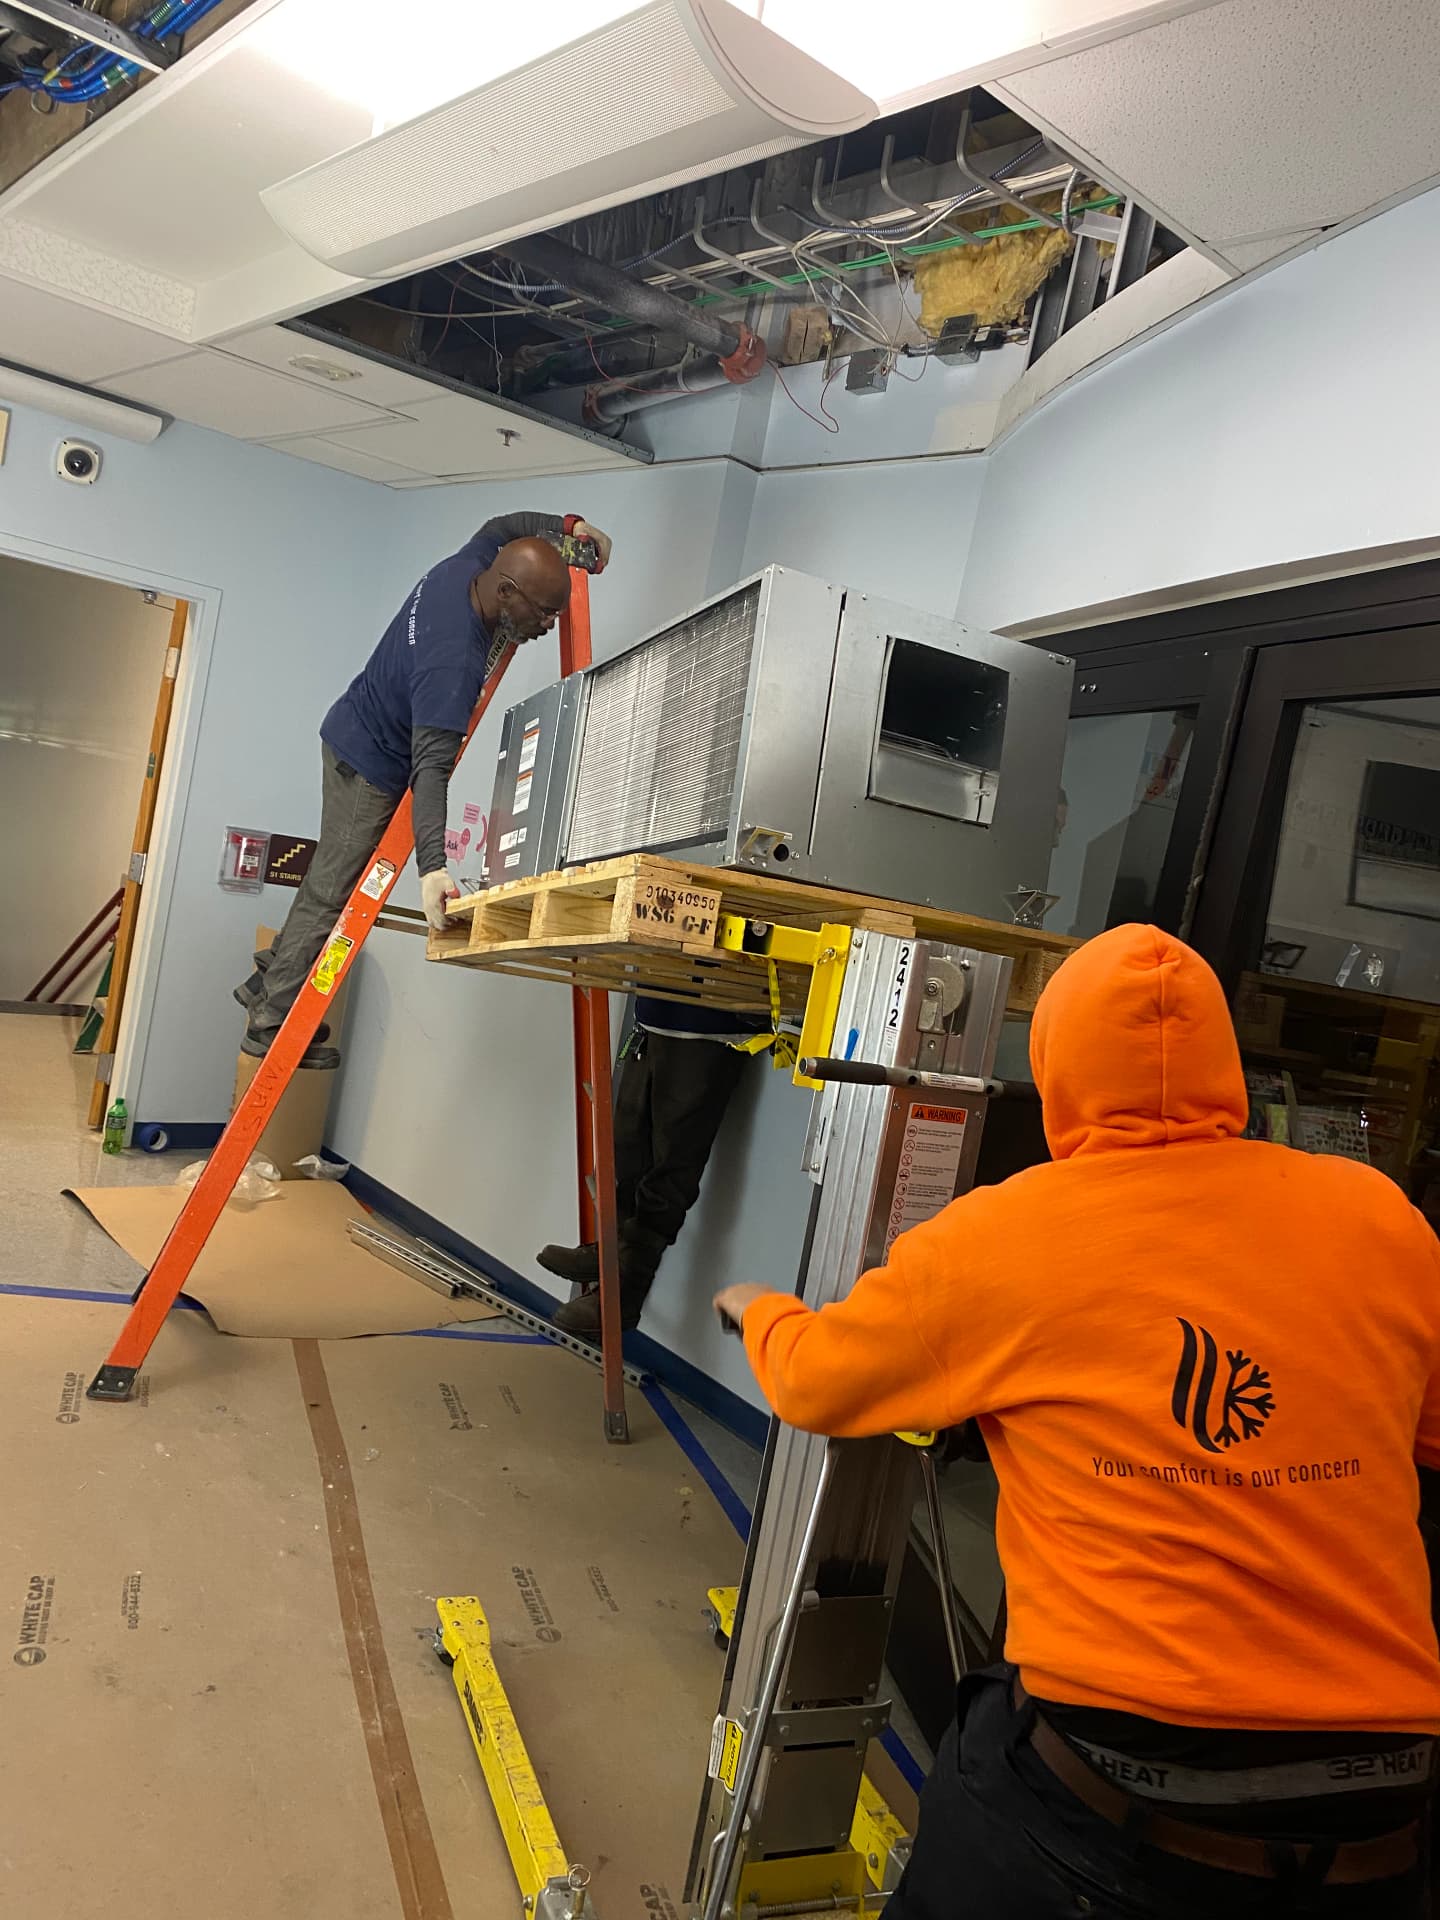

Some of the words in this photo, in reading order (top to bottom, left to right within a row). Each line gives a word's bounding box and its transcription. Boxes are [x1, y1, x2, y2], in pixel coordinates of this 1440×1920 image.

[446, 840, 459, 851] Ask
[279, 872, 302, 881] STAIRS
[927, 1108, 961, 1122] WARNING
[1139, 1462, 1218, 1487] comfort
[1224, 1467, 1244, 1487] is
[1251, 1468, 1281, 1489] our
[1287, 1458, 1360, 1484] concern
[27, 1575, 46, 1601] CAP
[511, 1566, 530, 1588] CAP
[519, 1589, 546, 1626] WHITE
[18, 1602, 42, 1645] WHITE
[1100, 1755, 1168, 1789] HEAT
[1382, 1751, 1425, 1776] HEAT
